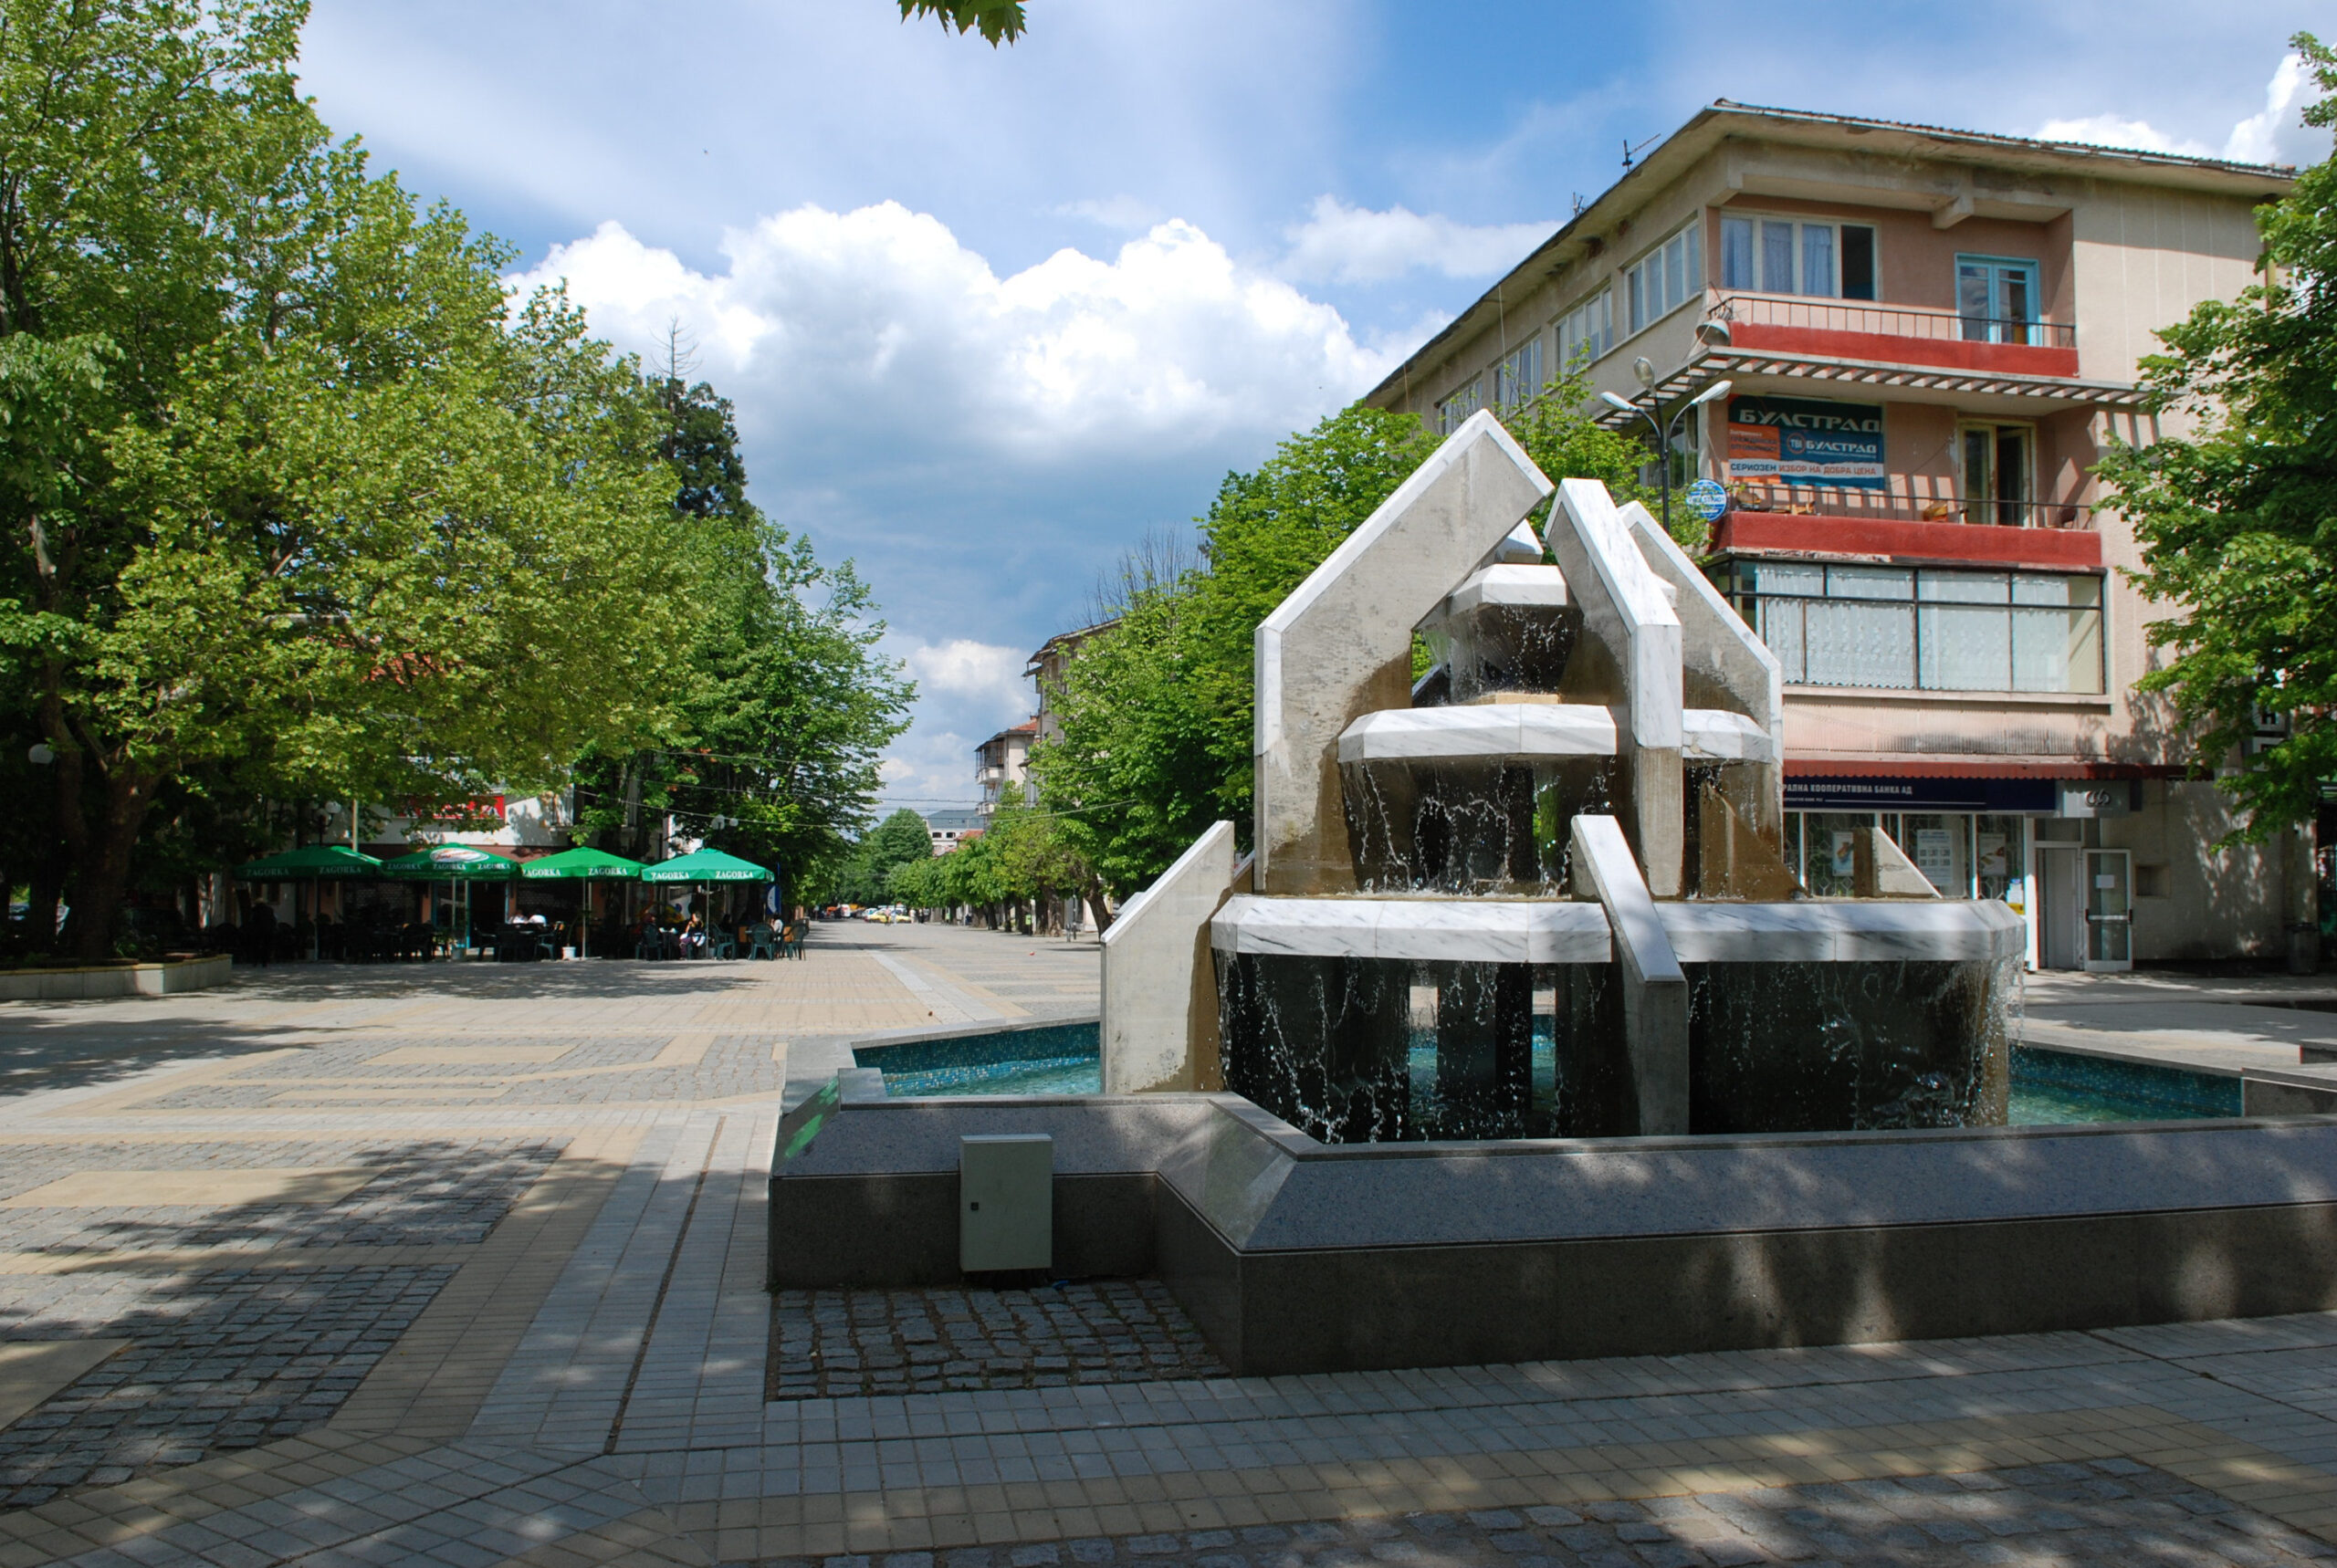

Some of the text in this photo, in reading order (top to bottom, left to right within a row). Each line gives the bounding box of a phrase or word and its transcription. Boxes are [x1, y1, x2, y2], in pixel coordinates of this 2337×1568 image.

[1739, 409, 1881, 434] БУЛСТРАД
[1805, 440, 1878, 455] БУЛСТРАД
[1730, 463, 1877, 476] СЕРИОЗЕН ИЗБОР НА ДОБРА ЦЕНА
[1810, 783, 1872, 793] КООПЕРАТИВНА
[1874, 785, 1900, 794] БАНКА
[1901, 786, 1913, 795] АД
[320, 866, 362, 874] ZAGORKA
[588, 867, 628, 876] ZAGORKA
[715, 870, 754, 879] ZAGORKA
[650, 872, 690, 880] ZAGORKA
